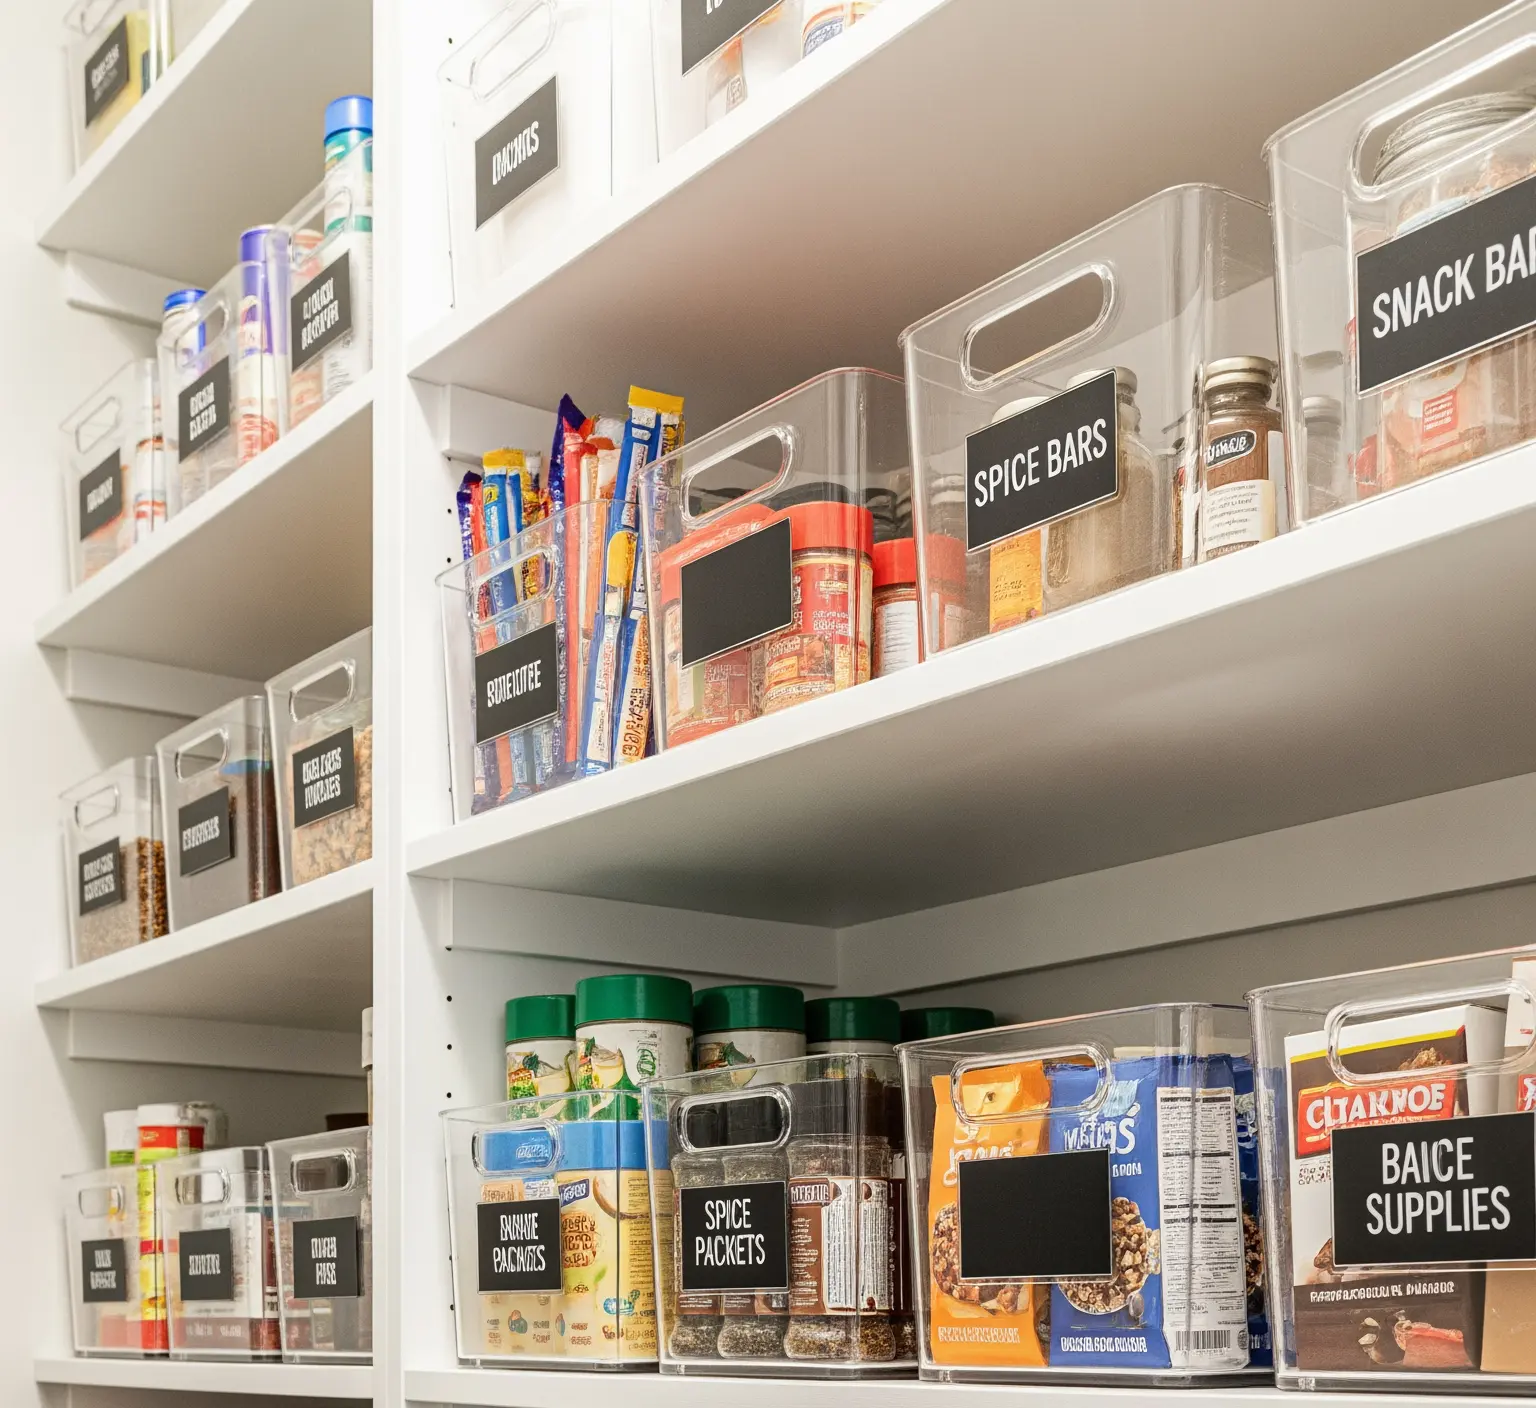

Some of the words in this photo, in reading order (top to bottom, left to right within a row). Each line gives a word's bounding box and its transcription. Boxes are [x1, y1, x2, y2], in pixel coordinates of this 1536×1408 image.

[1372, 253, 1475, 338] SNACK
[974, 445, 1040, 507] SPICE
[1047, 418, 1107, 478] BARS
[704, 1198, 752, 1230] SPICE
[1366, 1185, 1511, 1235] SUPPLIES
[695, 1233, 766, 1266] PACKETS
